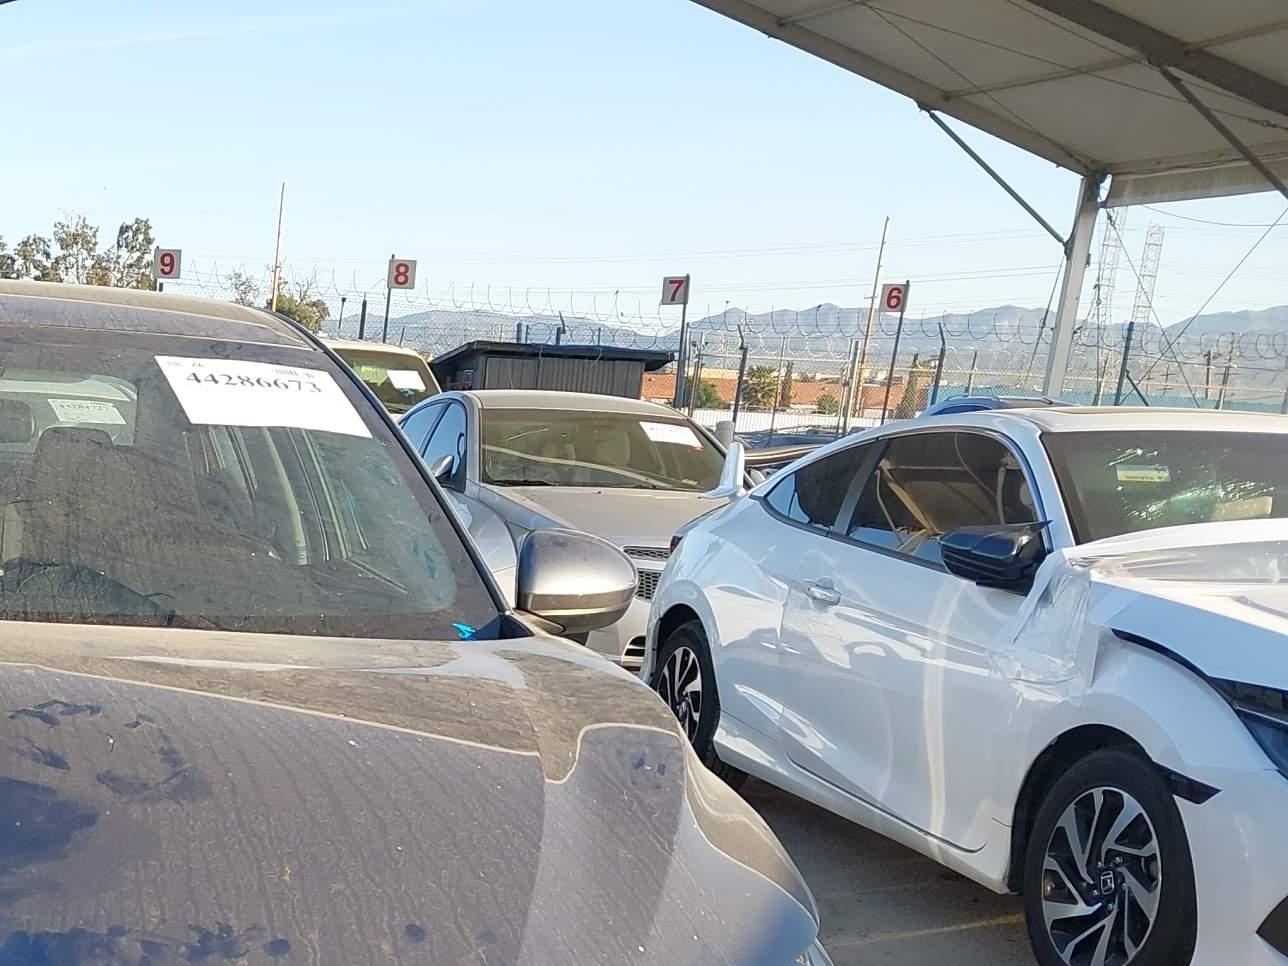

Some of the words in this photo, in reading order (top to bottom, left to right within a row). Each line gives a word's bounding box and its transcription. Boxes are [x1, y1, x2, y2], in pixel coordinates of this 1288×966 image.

[160, 252, 175, 275] 9
[394, 262, 409, 286] 8
[669, 279, 684, 302] 7
[886, 287, 903, 309] 6
[186, 372, 323, 393] 44286673
